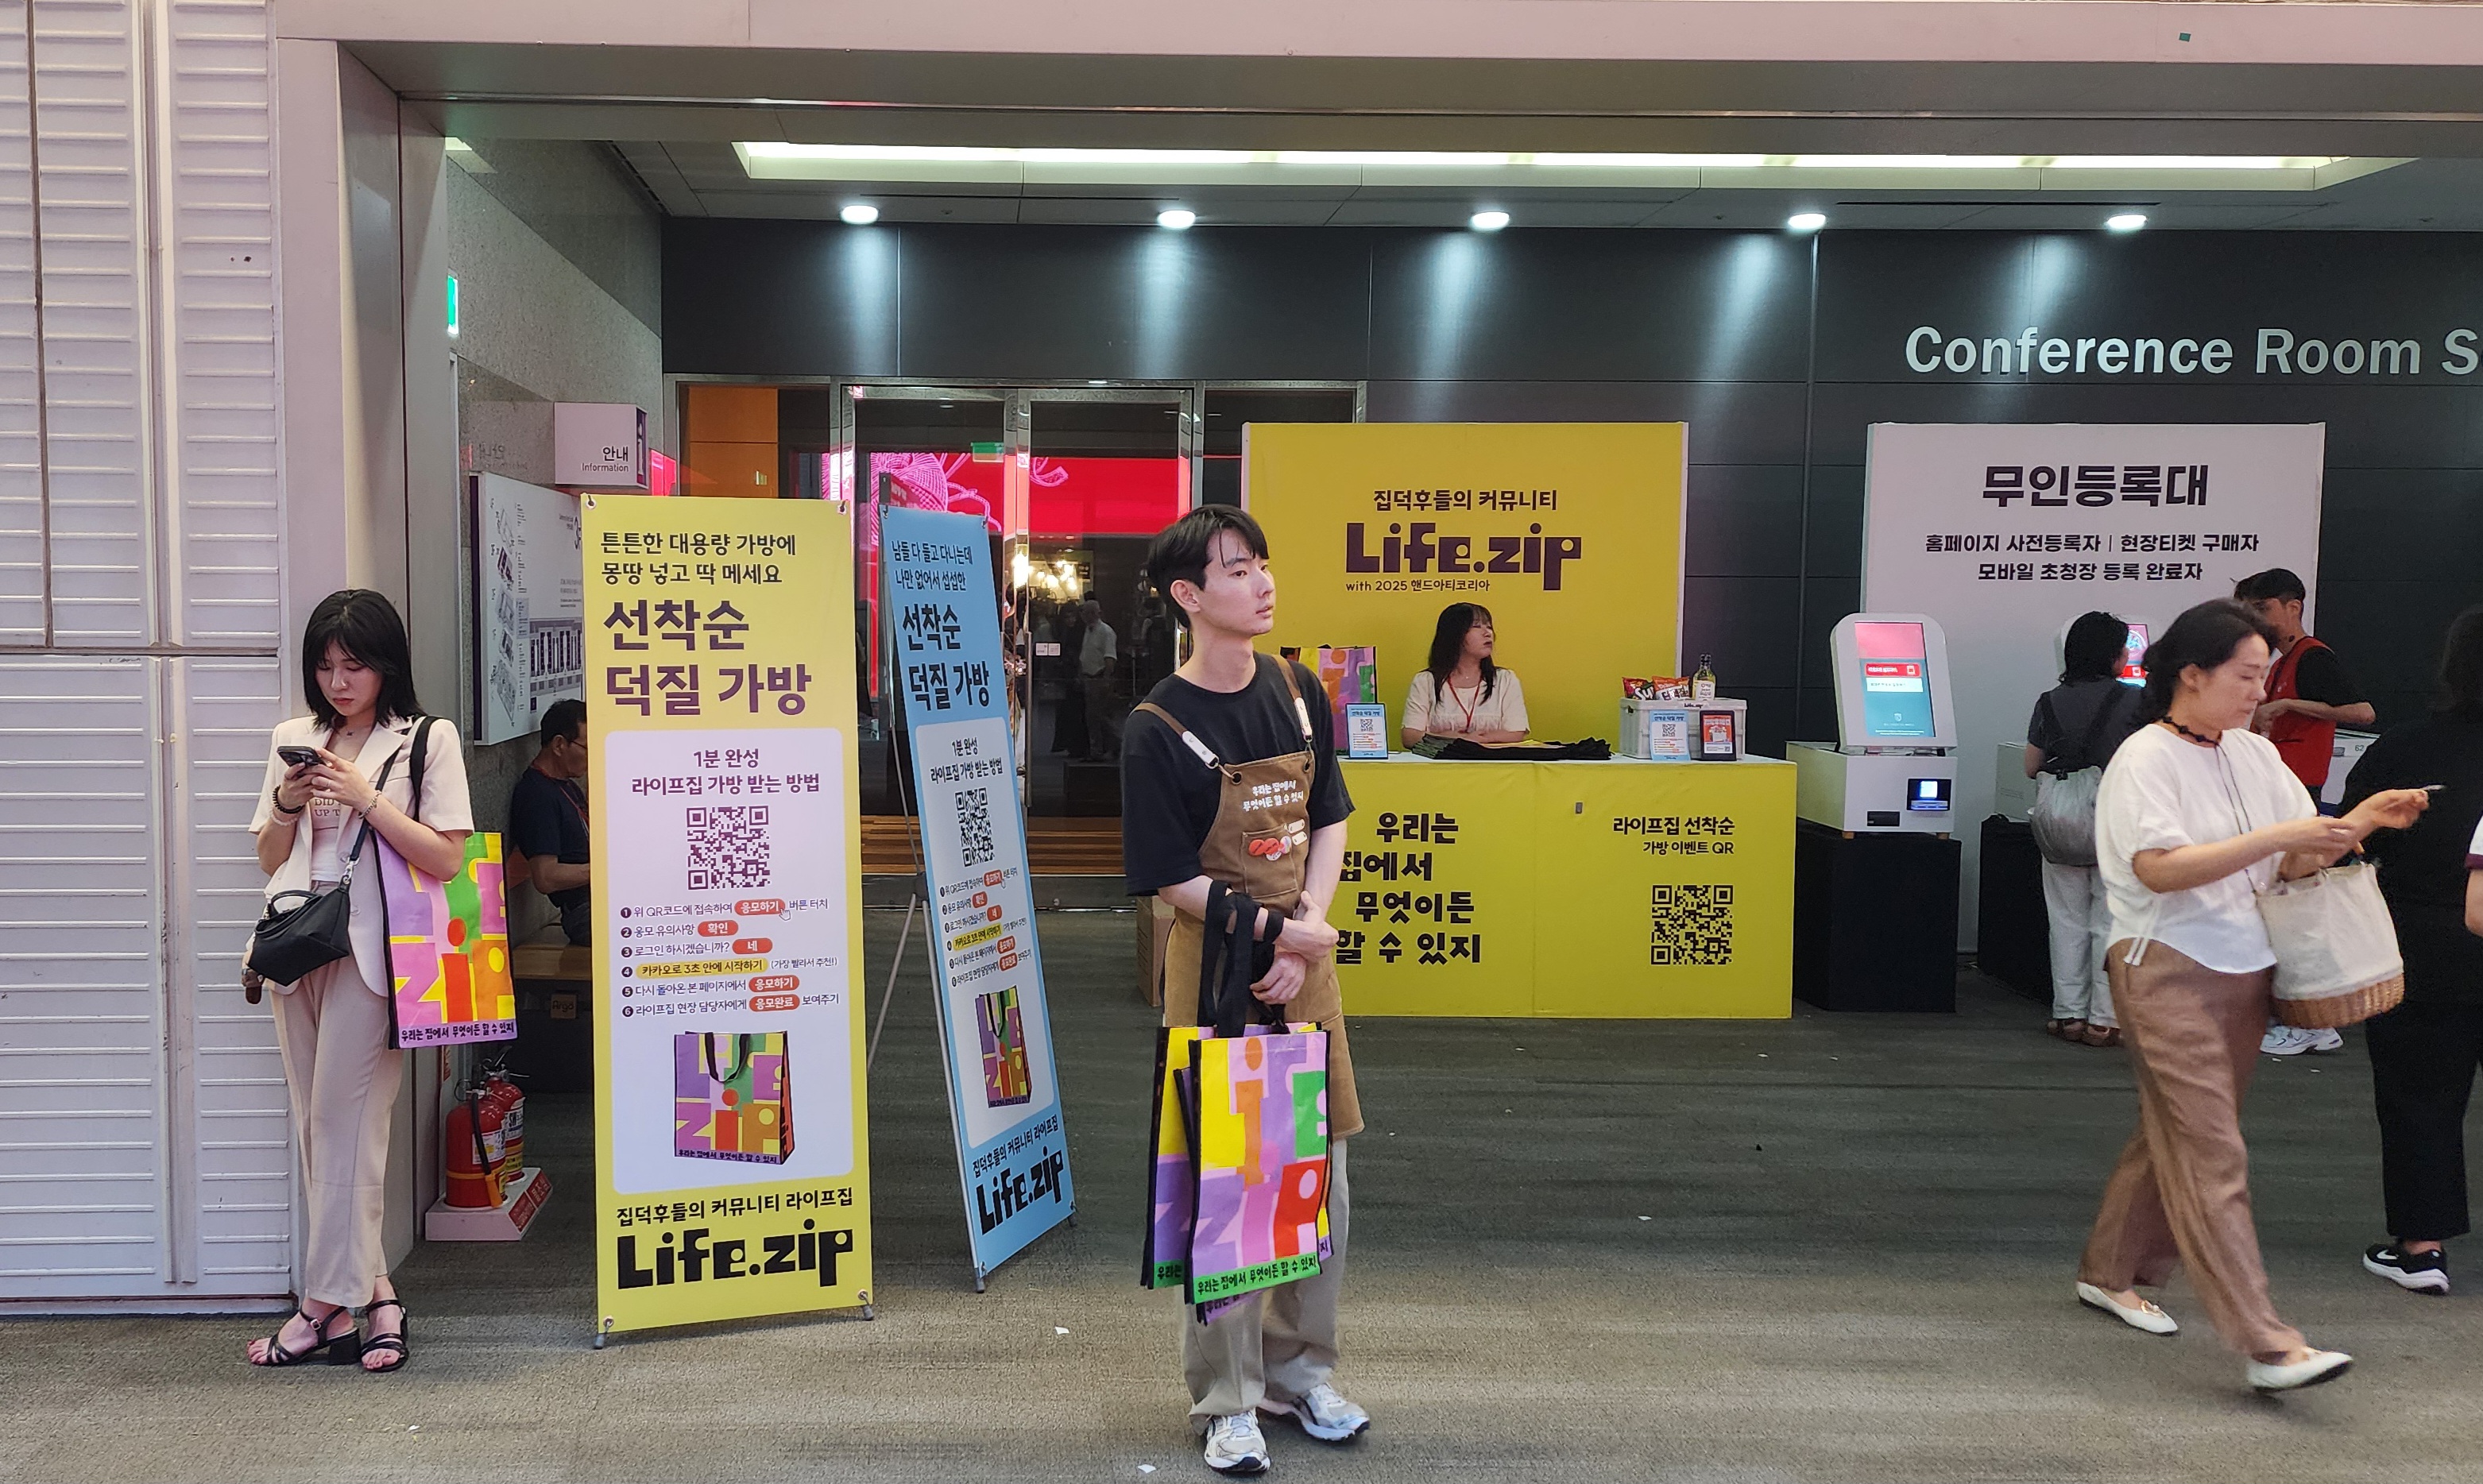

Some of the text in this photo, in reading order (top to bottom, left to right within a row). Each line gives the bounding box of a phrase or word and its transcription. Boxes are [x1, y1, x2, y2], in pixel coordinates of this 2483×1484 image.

[1906, 326, 2234, 376] Conference
[2256, 327, 2421, 374] Room
[602, 446, 628, 462] 안내
[582, 462, 628, 472] Information
[1982, 465, 2209, 508] 무인등록대
[1374, 489, 1557, 512] 집덕후들의 커뮤니티
[601, 532, 795, 555] 튼튼한 대용량 가방에
[891, 540, 973, 565] 남들 다 들고 다니는데
[1925, 534, 2259, 553] 홈페이지 사전등록자 현장티켓 구매자
[1346, 522, 1581, 591] Life.zip
[601, 562, 782, 585] 몽땅 넣고 딱 메세요
[895, 569, 966, 590] 나만 없어서 섭섭한
[1978, 562, 2203, 582] 모바일 초청장 등록 완료자
[1346, 581, 1372, 591] with
[1375, 581, 1407, 591] 2025
[604, 600, 749, 651] 선착순
[903, 604, 961, 651] 선착순
[606, 664, 812, 716] 덕질 가방
[908, 661, 990, 711] 덕질 가방
[694, 748, 759, 768] 1분 완성
[952, 737, 977, 756] 1분 완성
[930, 757, 1003, 784] 라이프집 가방 받는 방법
[632, 774, 820, 796] 라이프집 가방 받는 방법
[1376, 813, 1458, 844] 우리는
[1613, 816, 1735, 836] 라이프집 선착순
[1643, 841, 1734, 856] 가방 이벤트 QR
[1340, 851, 1433, 882] 집에서
[634, 907, 644, 918] 위
[647, 906, 693, 917] QR코드에
[694, 903, 733, 914] 접속하여
[741, 902, 778, 913] 응모하기
[789, 899, 807, 910] 버튼
[810, 899, 828, 910] 터치
[1356, 891, 1475, 925] 무엇이든
[634, 926, 654, 937] 응모
[656, 924, 694, 937] 유의사항
[708, 922, 728, 933] 확인
[635, 945, 663, 956] 로그인
[666, 942, 729, 955] 하시겠습니까?
[747, 941, 758, 951] 네
[1336, 932, 1481, 965] 할 수 있지
[642, 964, 682, 976] 카카오로
[684, 964, 700, 974] 3초
[702, 963, 722, 972] 안에
[725, 960, 762, 972] 시작하기
[771, 960, 789, 969] (가장
[816, 957, 838, 967] 추천!)
[636, 984, 655, 995] 다시
[656, 984, 686, 995] 돌아온
[688, 984, 698, 993] 본
[699, 980, 746, 992] 페이지에서
[755, 977, 793, 989] 응모하기
[636, 1003, 675, 1016] 라이프집
[677, 1003, 696, 1014] 현장
[699, 999, 747, 1013] 담당자에게
[756, 997, 794, 1010] 응모완료
[802, 994, 839, 1006] 보여주기
[401, 1022, 513, 1042] 우리는 집에서 무엇이든 할 수 있지
[973, 1114, 1058, 1178] 집덕후들의 커뮤니티 라이프집
[976, 1146, 1064, 1235] Life.zip
[617, 1188, 853, 1227] 집덕후들의 커뮤니티 라이프집
[617, 1219, 853, 1289] Life.zip
[1197, 1281, 1218, 1295] 우리는
[1220, 1272, 1247, 1290] 집에서
[1250, 1263, 1278, 1282] 무엇이든
[1292, 1260, 1298, 1270] 수
[1301, 1255, 1316, 1271] 있지
